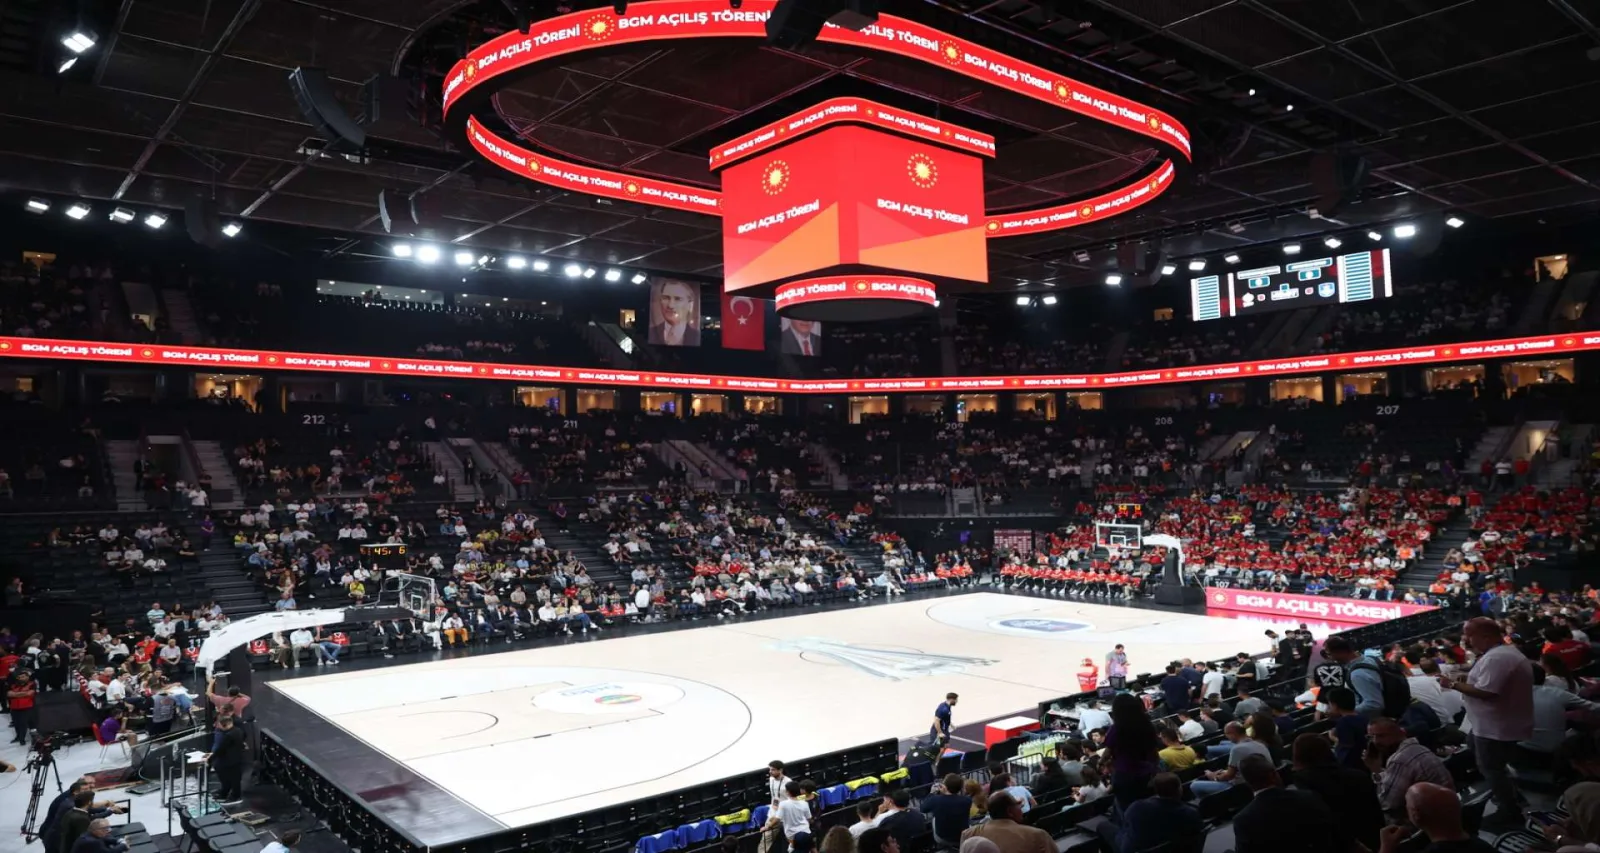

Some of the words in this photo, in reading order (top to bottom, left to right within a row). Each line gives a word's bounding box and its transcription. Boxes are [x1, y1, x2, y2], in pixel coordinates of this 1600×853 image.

[618, 14, 653, 30] BGM
[657, 11, 708, 27] AÇILIŞ
[860, 24, 894, 41] ÇILIŞ
[897, 30, 939, 52] TÖRENİ
[478, 52, 497, 70] BGM
[499, 39, 532, 60] AÇILIŞ
[534, 23, 581, 47] TÖRENİ
[964, 52, 987, 69] BGM
[989, 62, 1018, 82] AÇILIŞ
[1019, 72, 1053, 92] TÖRENİ
[1072, 91, 1092, 106] BGM
[1093, 98, 1118, 116] AÇILIŞ
[1118, 106, 1146, 124] TÖRENİ
[543, 165, 561, 177] BGM
[562, 171, 589, 185] AÇILIŞ
[590, 177, 622, 190] TÖRENİ
[737, 220, 757, 235] BGM
[756, 211, 785, 229] AÇILIŞ
[786, 198, 820, 219] TÖRENİ
[876, 198, 901, 212] BGM
[902, 203, 933, 220] AÇILIŞ
[934, 209, 969, 225] TÖRENİ
[806, 281, 847, 295] TÖRENİ
[870, 282, 897, 292] BGM
[1459, 346, 1483, 355] BGM
[1484, 343, 1515, 353] AÇILIŞ
[1516, 339, 1555, 350] TÖRENİ
[1583, 336, 1600, 345] BG
[21, 343, 50, 352] BGM
[52, 345, 88, 356] AÇILIŞ
[90, 346, 133, 356] TÖRENİ
[162, 350, 187, 359] BGM
[189, 352, 221, 362] AÇILIŞ
[222, 353, 259, 363] TÖRENİ
[284, 357, 307, 365] BGM
[308, 358, 337, 368] AÇILIŞ
[338, 359, 371, 368] TÖRENİ
[1376, 405, 1400, 415] 207
[302, 414, 326, 425] 212
[563, 420, 578, 428] 211
[1155, 416, 1173, 425] 208
[1237, 595, 1272, 607] BGM
[1277, 600, 1328, 615] AÇILIŞ
[1333, 603, 1400, 619] TÖRENİ
